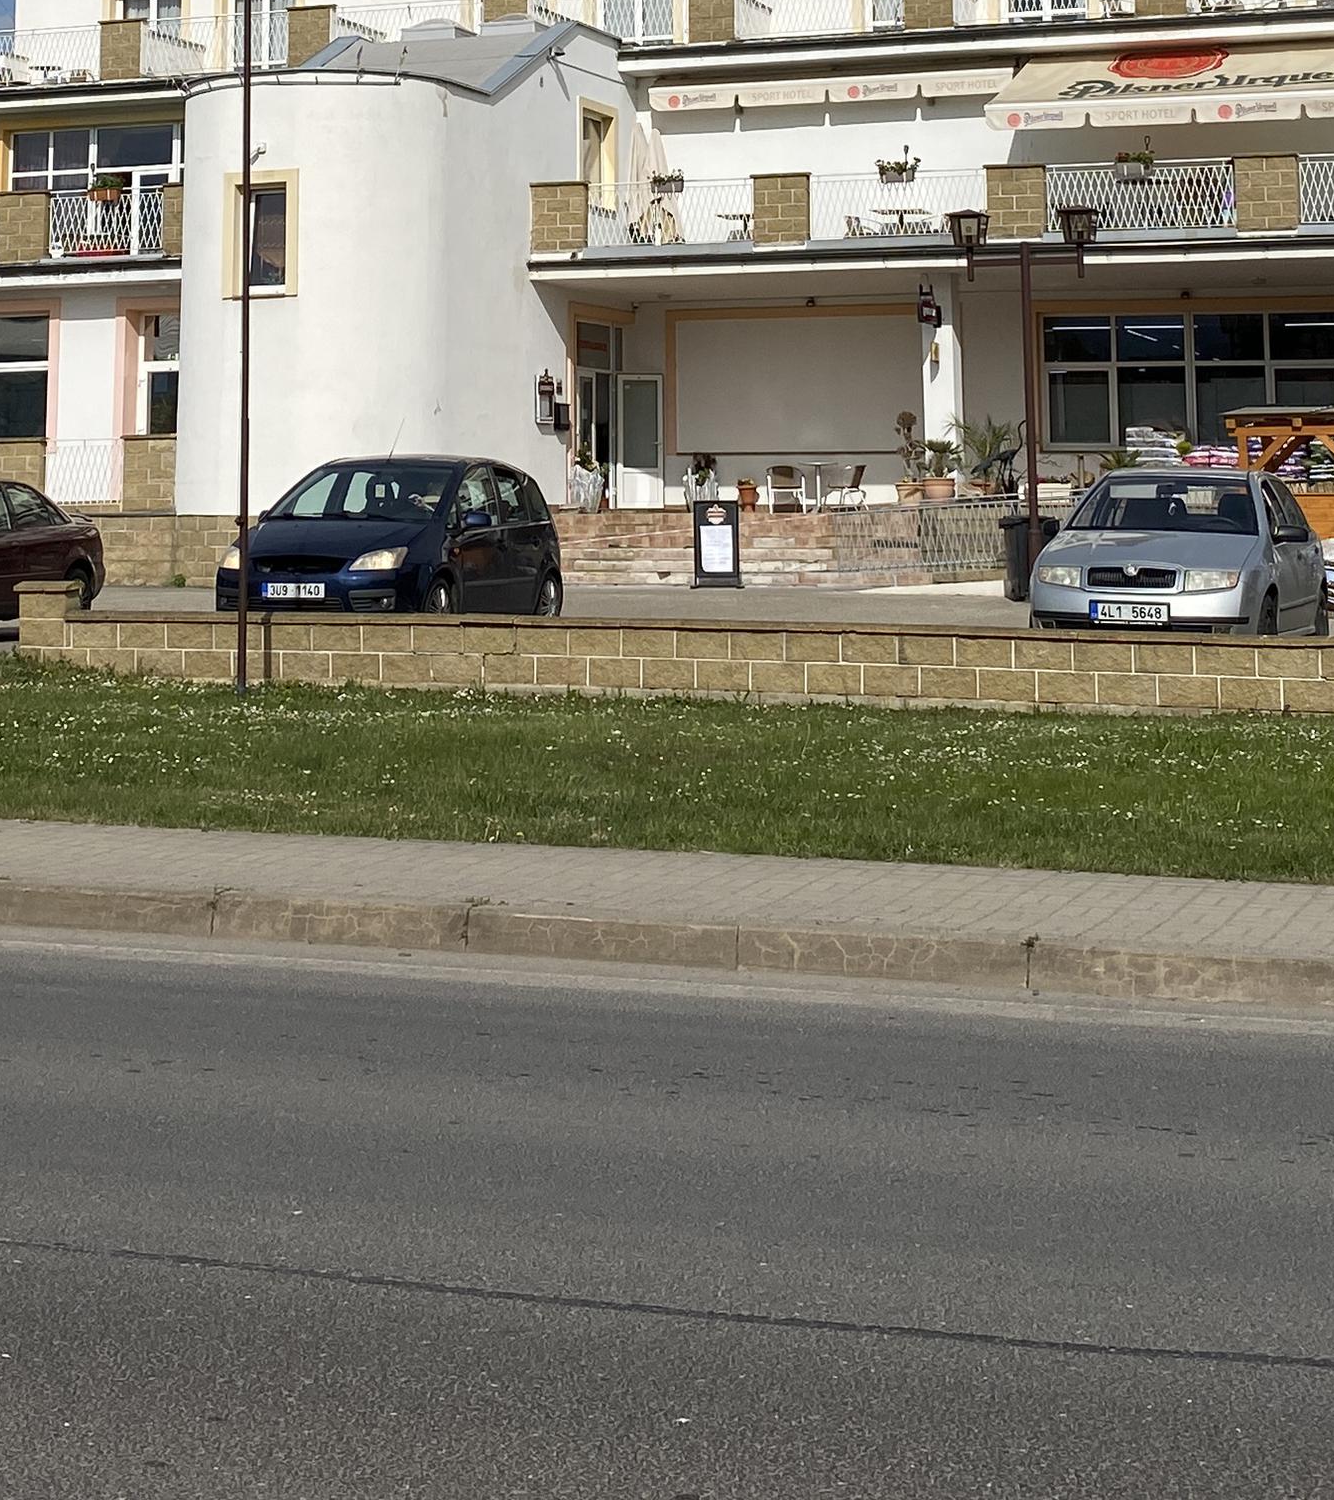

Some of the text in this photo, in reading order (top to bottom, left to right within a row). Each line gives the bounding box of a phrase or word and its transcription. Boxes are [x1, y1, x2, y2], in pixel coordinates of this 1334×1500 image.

[1058, 79, 1214, 100] Pilsner
[1105, 108, 1177, 121] SPORT HOTEL
[270, 585, 320, 596] 3U9 1140
[1100, 605, 1162, 619] 4L1 5648
